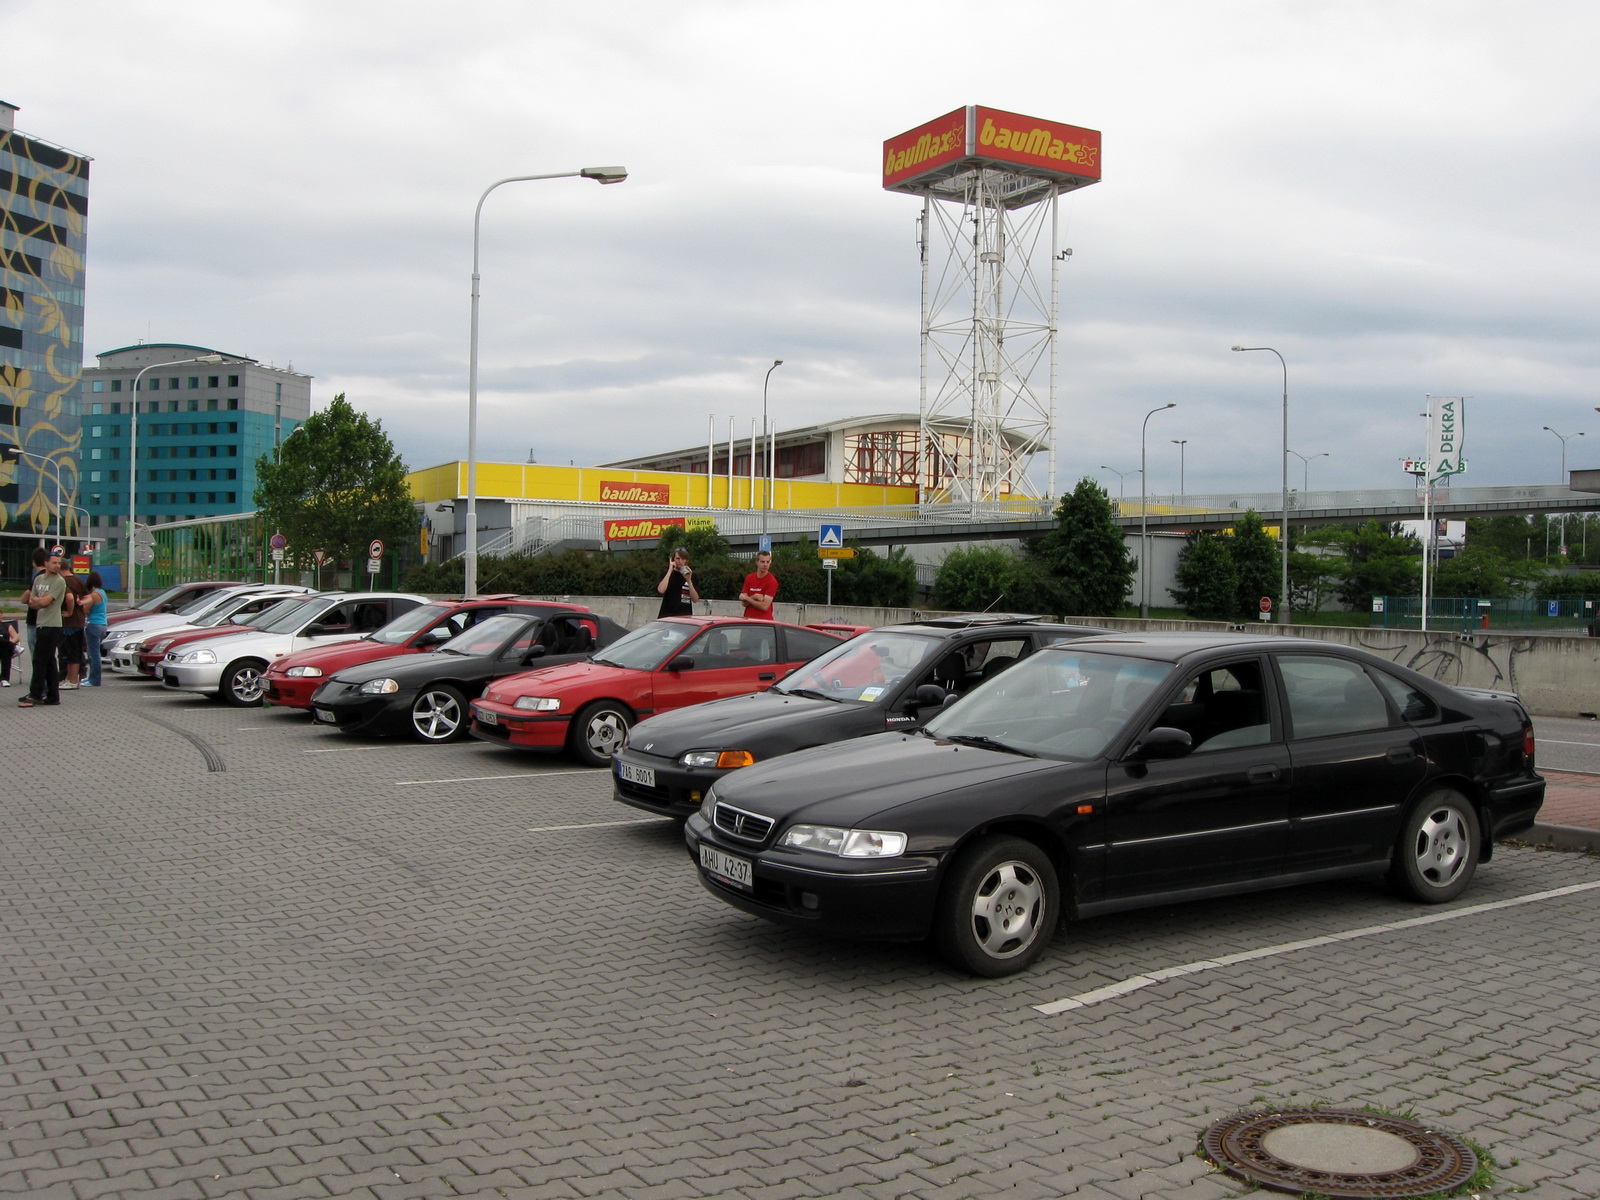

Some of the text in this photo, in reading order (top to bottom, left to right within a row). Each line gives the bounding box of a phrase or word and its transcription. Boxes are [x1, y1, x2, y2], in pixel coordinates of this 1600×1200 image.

[1440, 401, 1454, 453] DEKRA
[687, 518, 711, 526] Vitáme
[704, 848, 719, 870] AHU
[724, 856, 748, 882] 42-37
